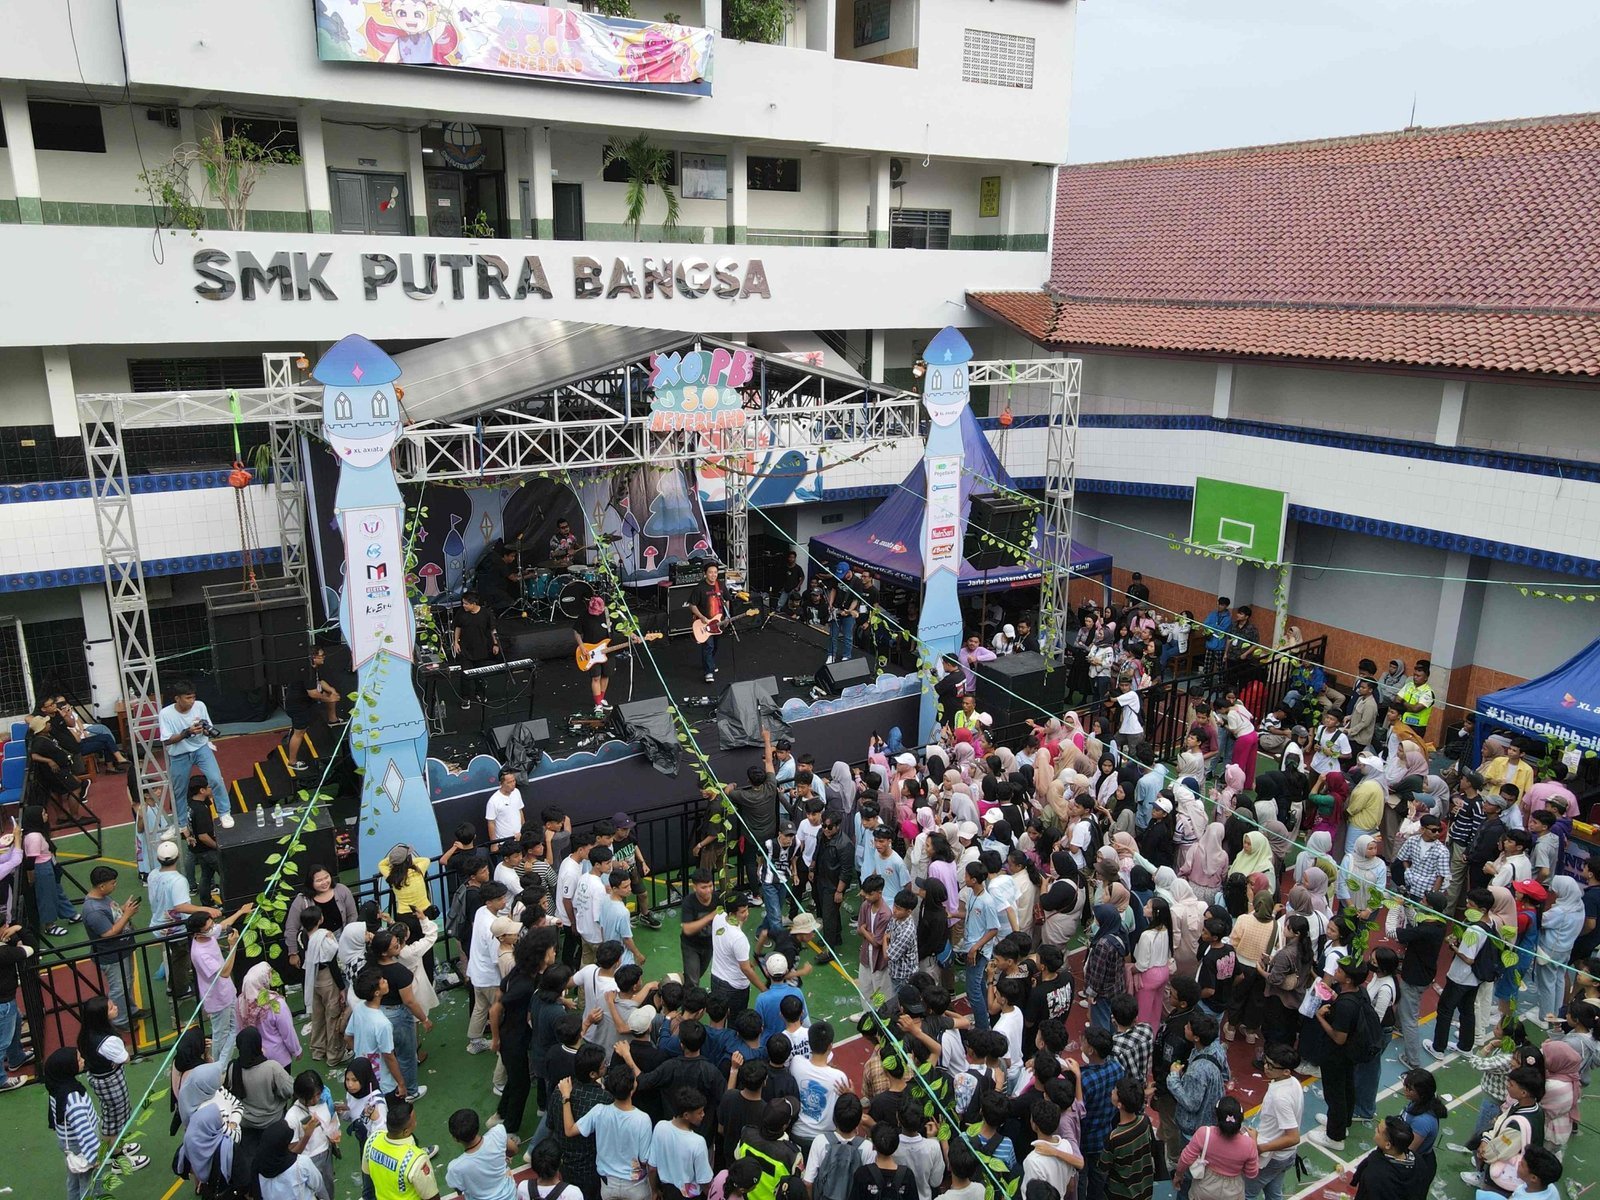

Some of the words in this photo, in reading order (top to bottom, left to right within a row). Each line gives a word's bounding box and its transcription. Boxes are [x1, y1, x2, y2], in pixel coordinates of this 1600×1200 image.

[498, 51, 583, 73] NEVERLAND
[193, 248, 338, 301] SMK
[361, 252, 553, 301] PUTRA
[572, 256, 771, 301] BANGSA
[681, 385, 719, 412] 5.0
[651, 409, 747, 432] NEVERLAND
[999, 574, 1027, 585] Internet
[1577, 701, 1591, 712] XL
[371, 1149, 396, 1170] SECURITY
